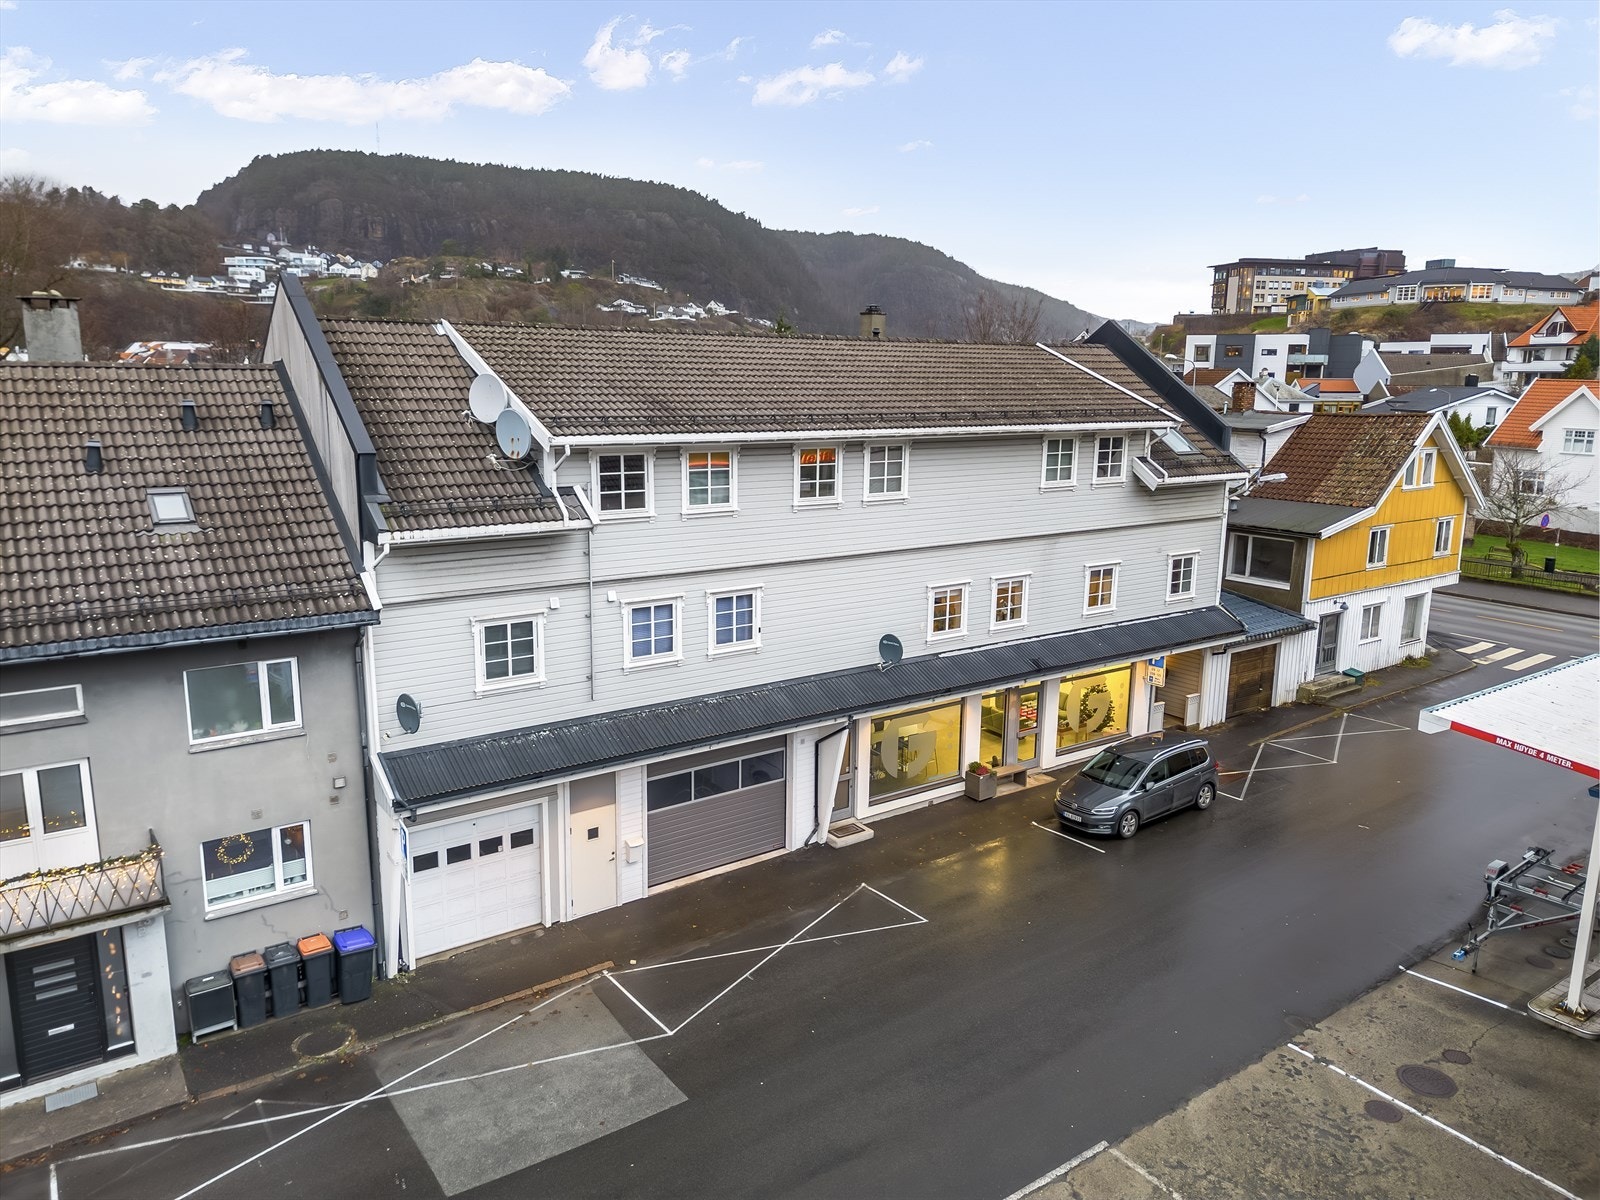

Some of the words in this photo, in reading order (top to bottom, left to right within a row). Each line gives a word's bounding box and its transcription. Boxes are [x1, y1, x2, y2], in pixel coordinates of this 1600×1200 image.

[1496, 737, 1512, 748] MAX
[1514, 743, 1537, 756] HØYDE
[1546, 754, 1574, 769] METER.
